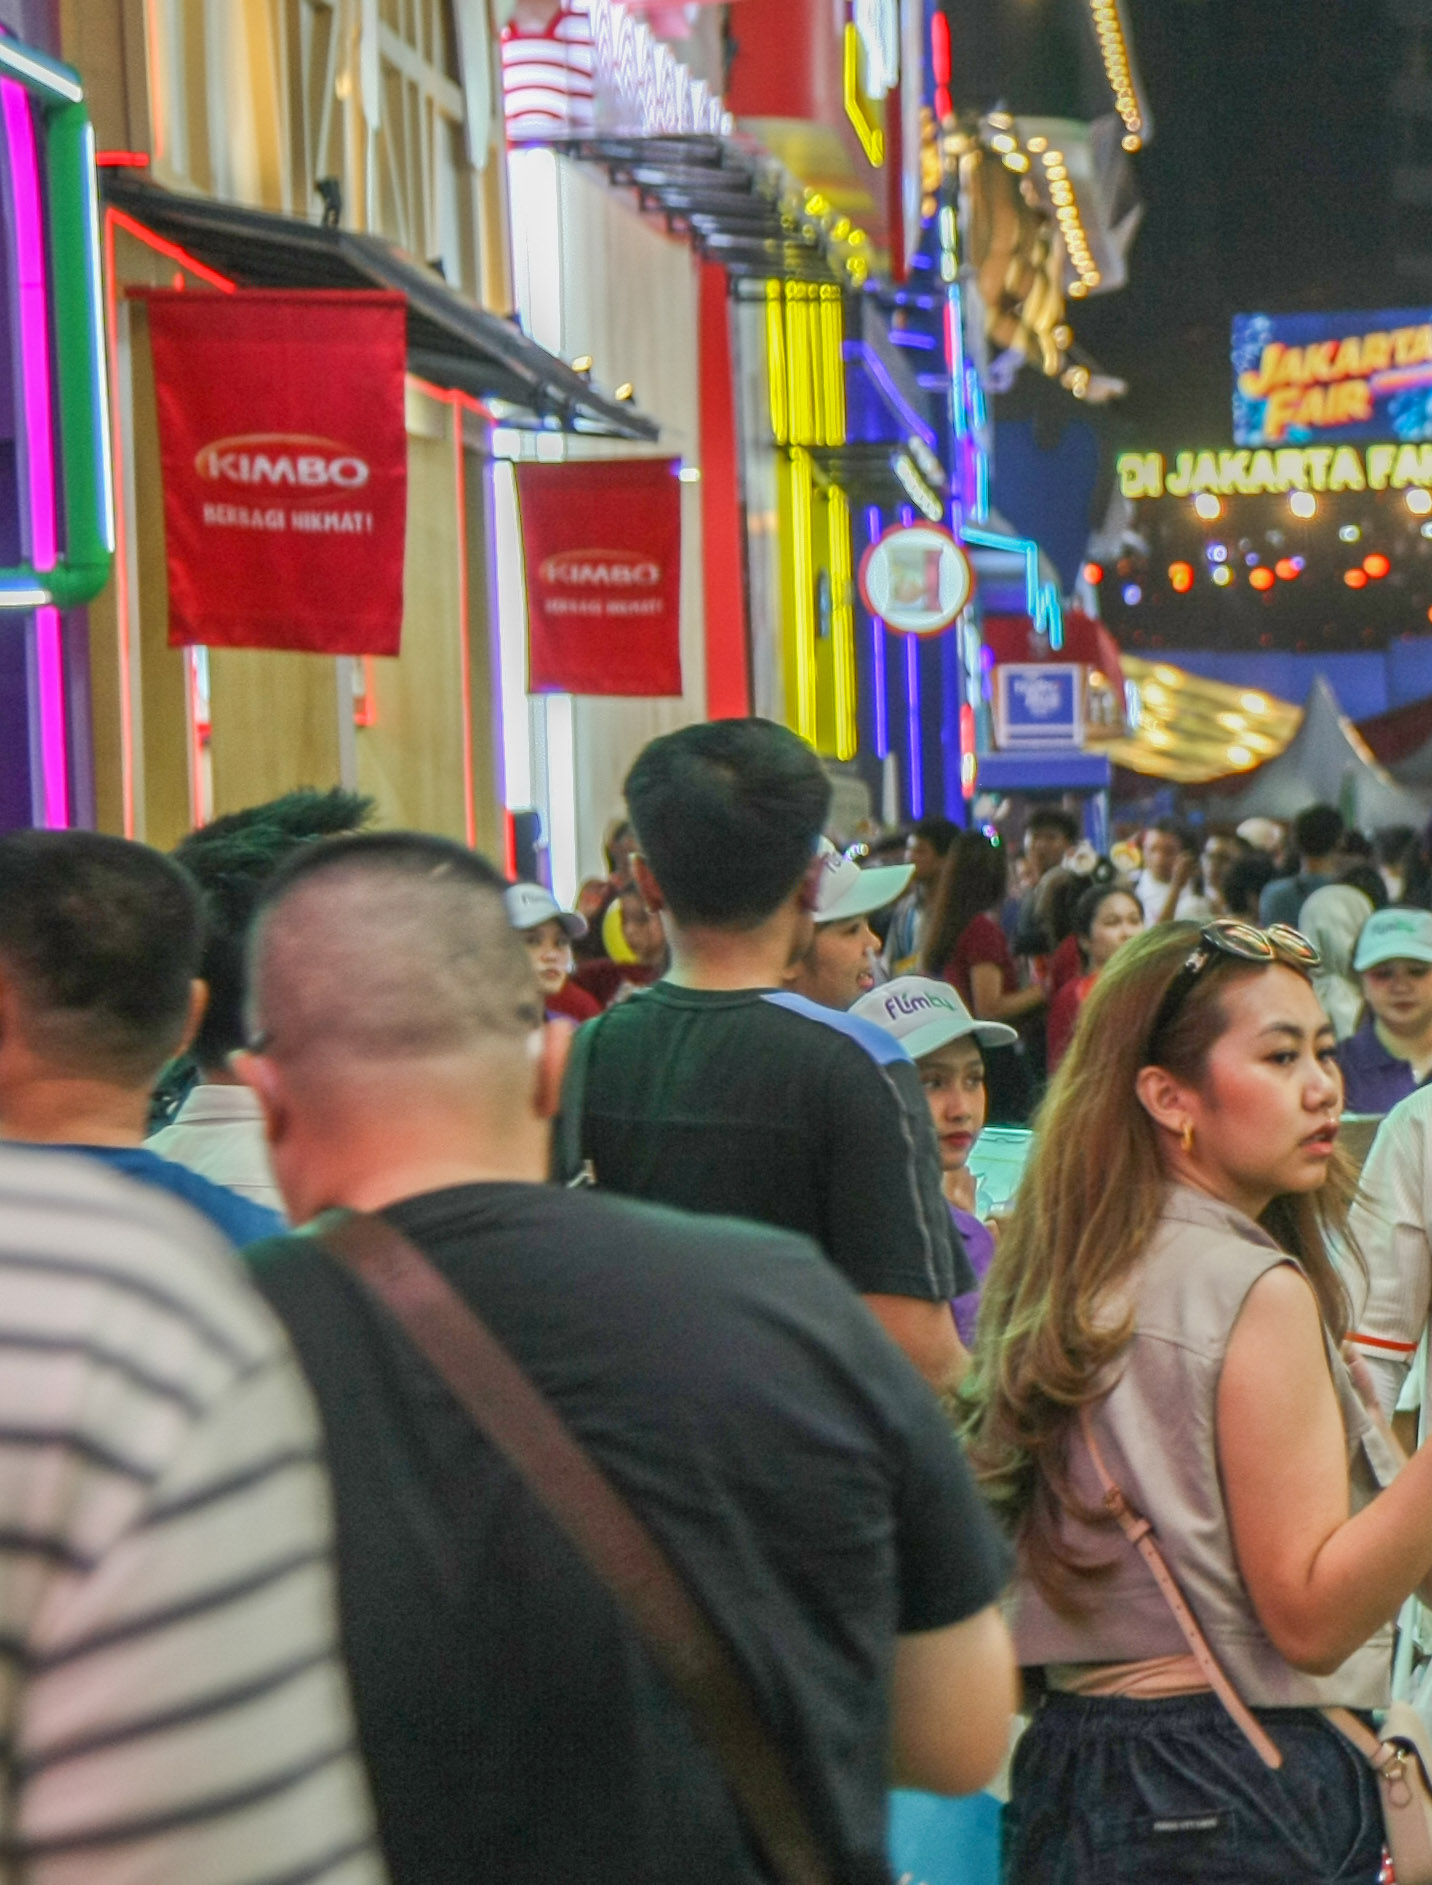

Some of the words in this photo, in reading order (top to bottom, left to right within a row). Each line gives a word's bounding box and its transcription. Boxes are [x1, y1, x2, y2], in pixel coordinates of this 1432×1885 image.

[1264, 379, 1374, 442] FAIR
[207, 449, 370, 488] KIMBO
[1116, 452, 1164, 498] DI
[1165, 446, 1366, 497] JAKARTA
